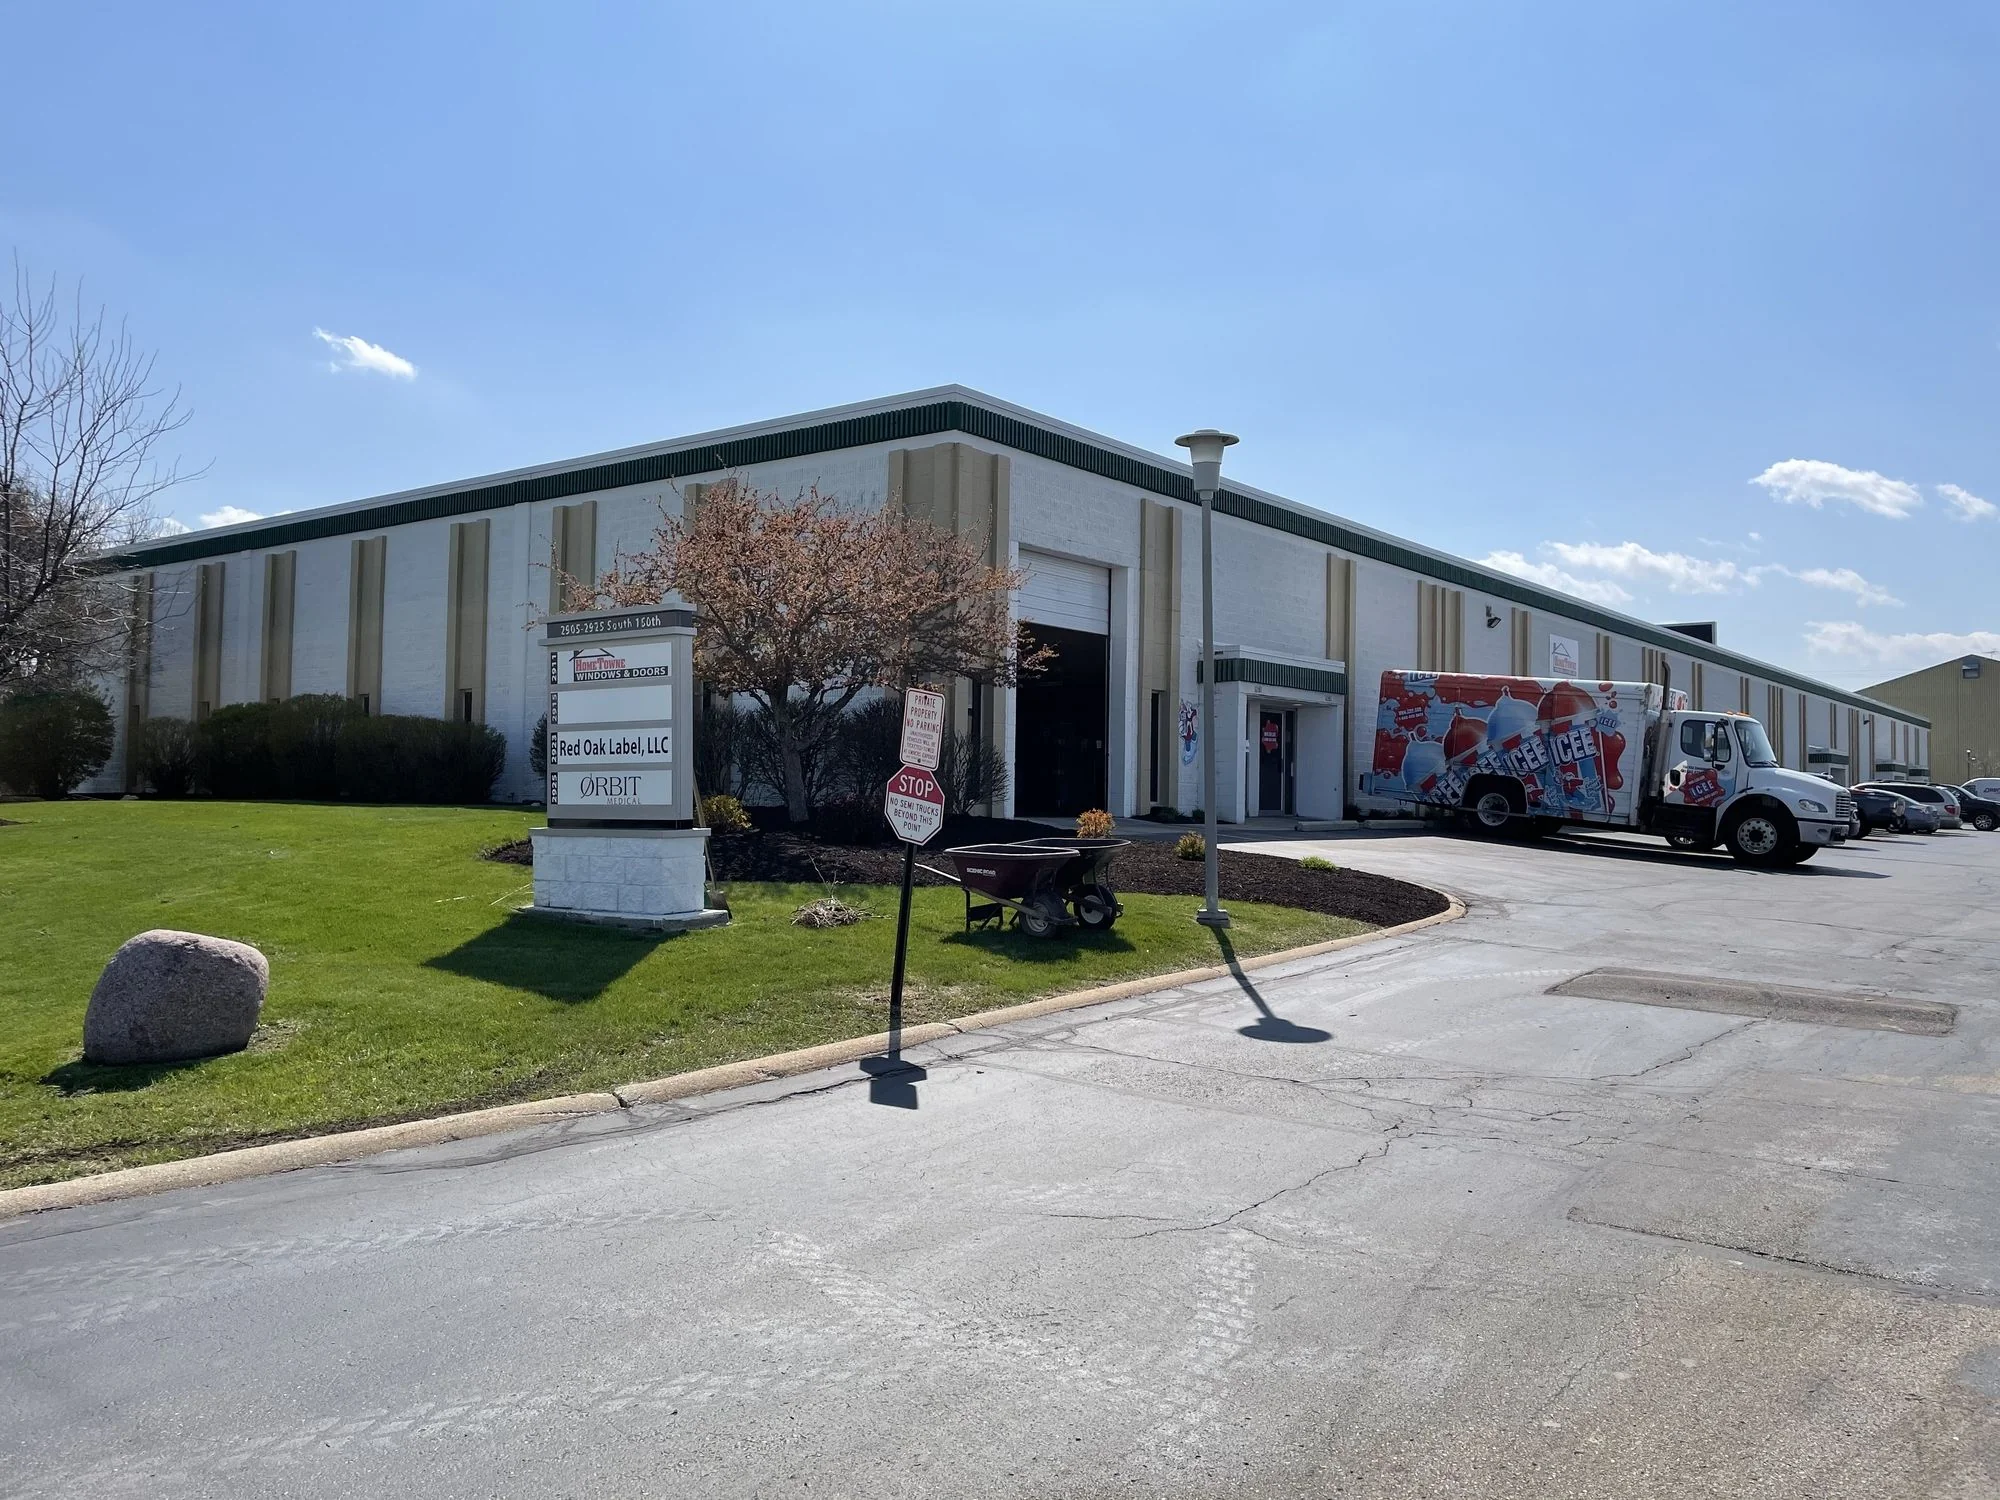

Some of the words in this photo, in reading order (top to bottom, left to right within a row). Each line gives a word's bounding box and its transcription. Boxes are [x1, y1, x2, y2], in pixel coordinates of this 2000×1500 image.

[607, 617, 632, 631] South
[636, 615, 661, 627] 150th
[576, 669, 621, 680] WINDOWS
[623, 669, 631, 678] &
[632, 667, 666, 677] DOORS
[914, 695, 936, 708] PRIVATE
[911, 706, 937, 720] PROPERTY
[907, 718, 914, 728] NO
[916, 720, 940, 734] PARKING
[560, 739, 580, 756] Red
[584, 738, 606, 756] Oak
[609, 736, 645, 757] Label,
[647, 736, 668, 754] LLC
[1550, 728, 1597, 766] ICEE
[1501, 737, 1549, 776] ICEE
[899, 774, 934, 798] STOP
[1691, 780, 1714, 796] ICEE
[890, 796, 899, 806] NO
[900, 799, 914, 810] SEMI
[916, 803, 939, 817] TRUCKS
[894, 809, 918, 822] BEYOND
[919, 815, 933, 826] THIS
[904, 821, 921, 832] POINT
